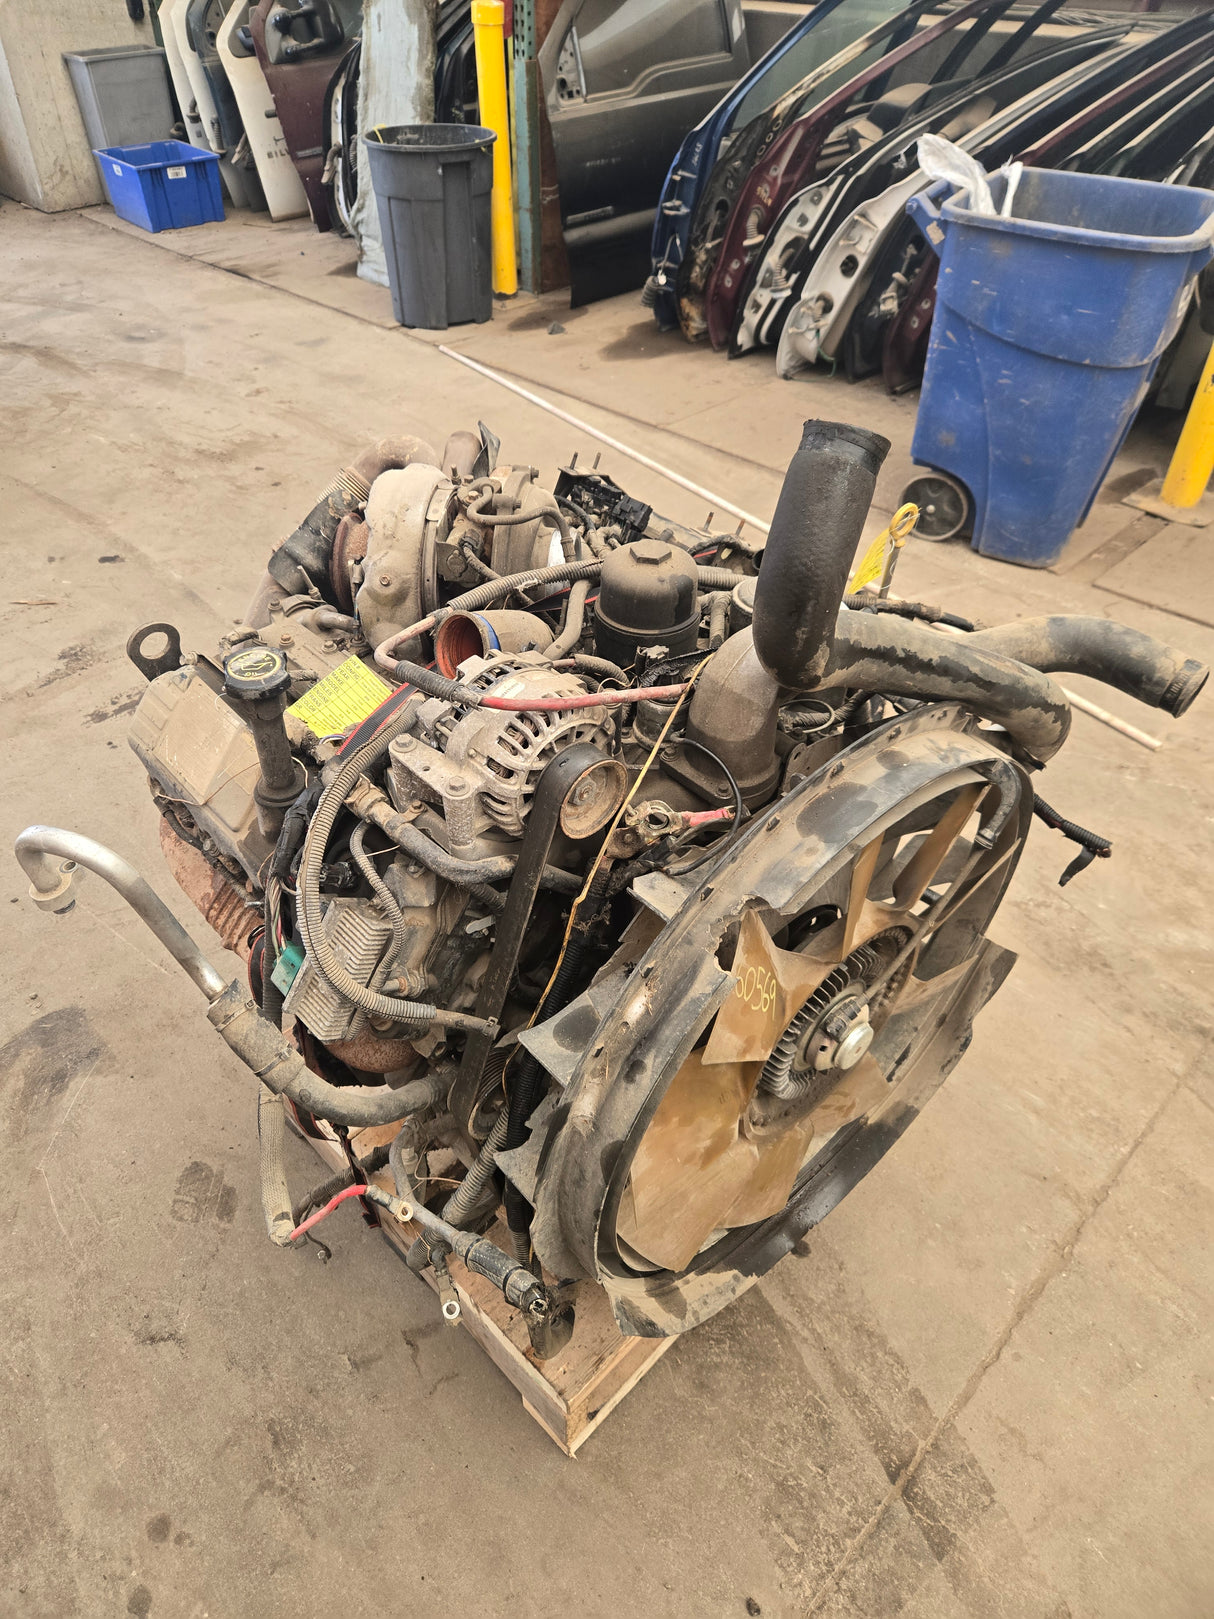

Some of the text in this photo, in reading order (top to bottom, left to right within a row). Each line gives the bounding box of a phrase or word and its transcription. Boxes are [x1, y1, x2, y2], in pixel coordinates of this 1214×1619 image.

[330, 671, 344, 686] MAKE
[335, 666, 350, 680] YEAR
[342, 661, 360, 680] CONFIG
[318, 681, 333, 696] MILES
[323, 676, 341, 693] MODEL
[306, 691, 322, 707] TRANS
[311, 685, 330, 704] ENGINE
[299, 696, 316, 713] COLOR
[735, 965, 776, 1021] 60569
